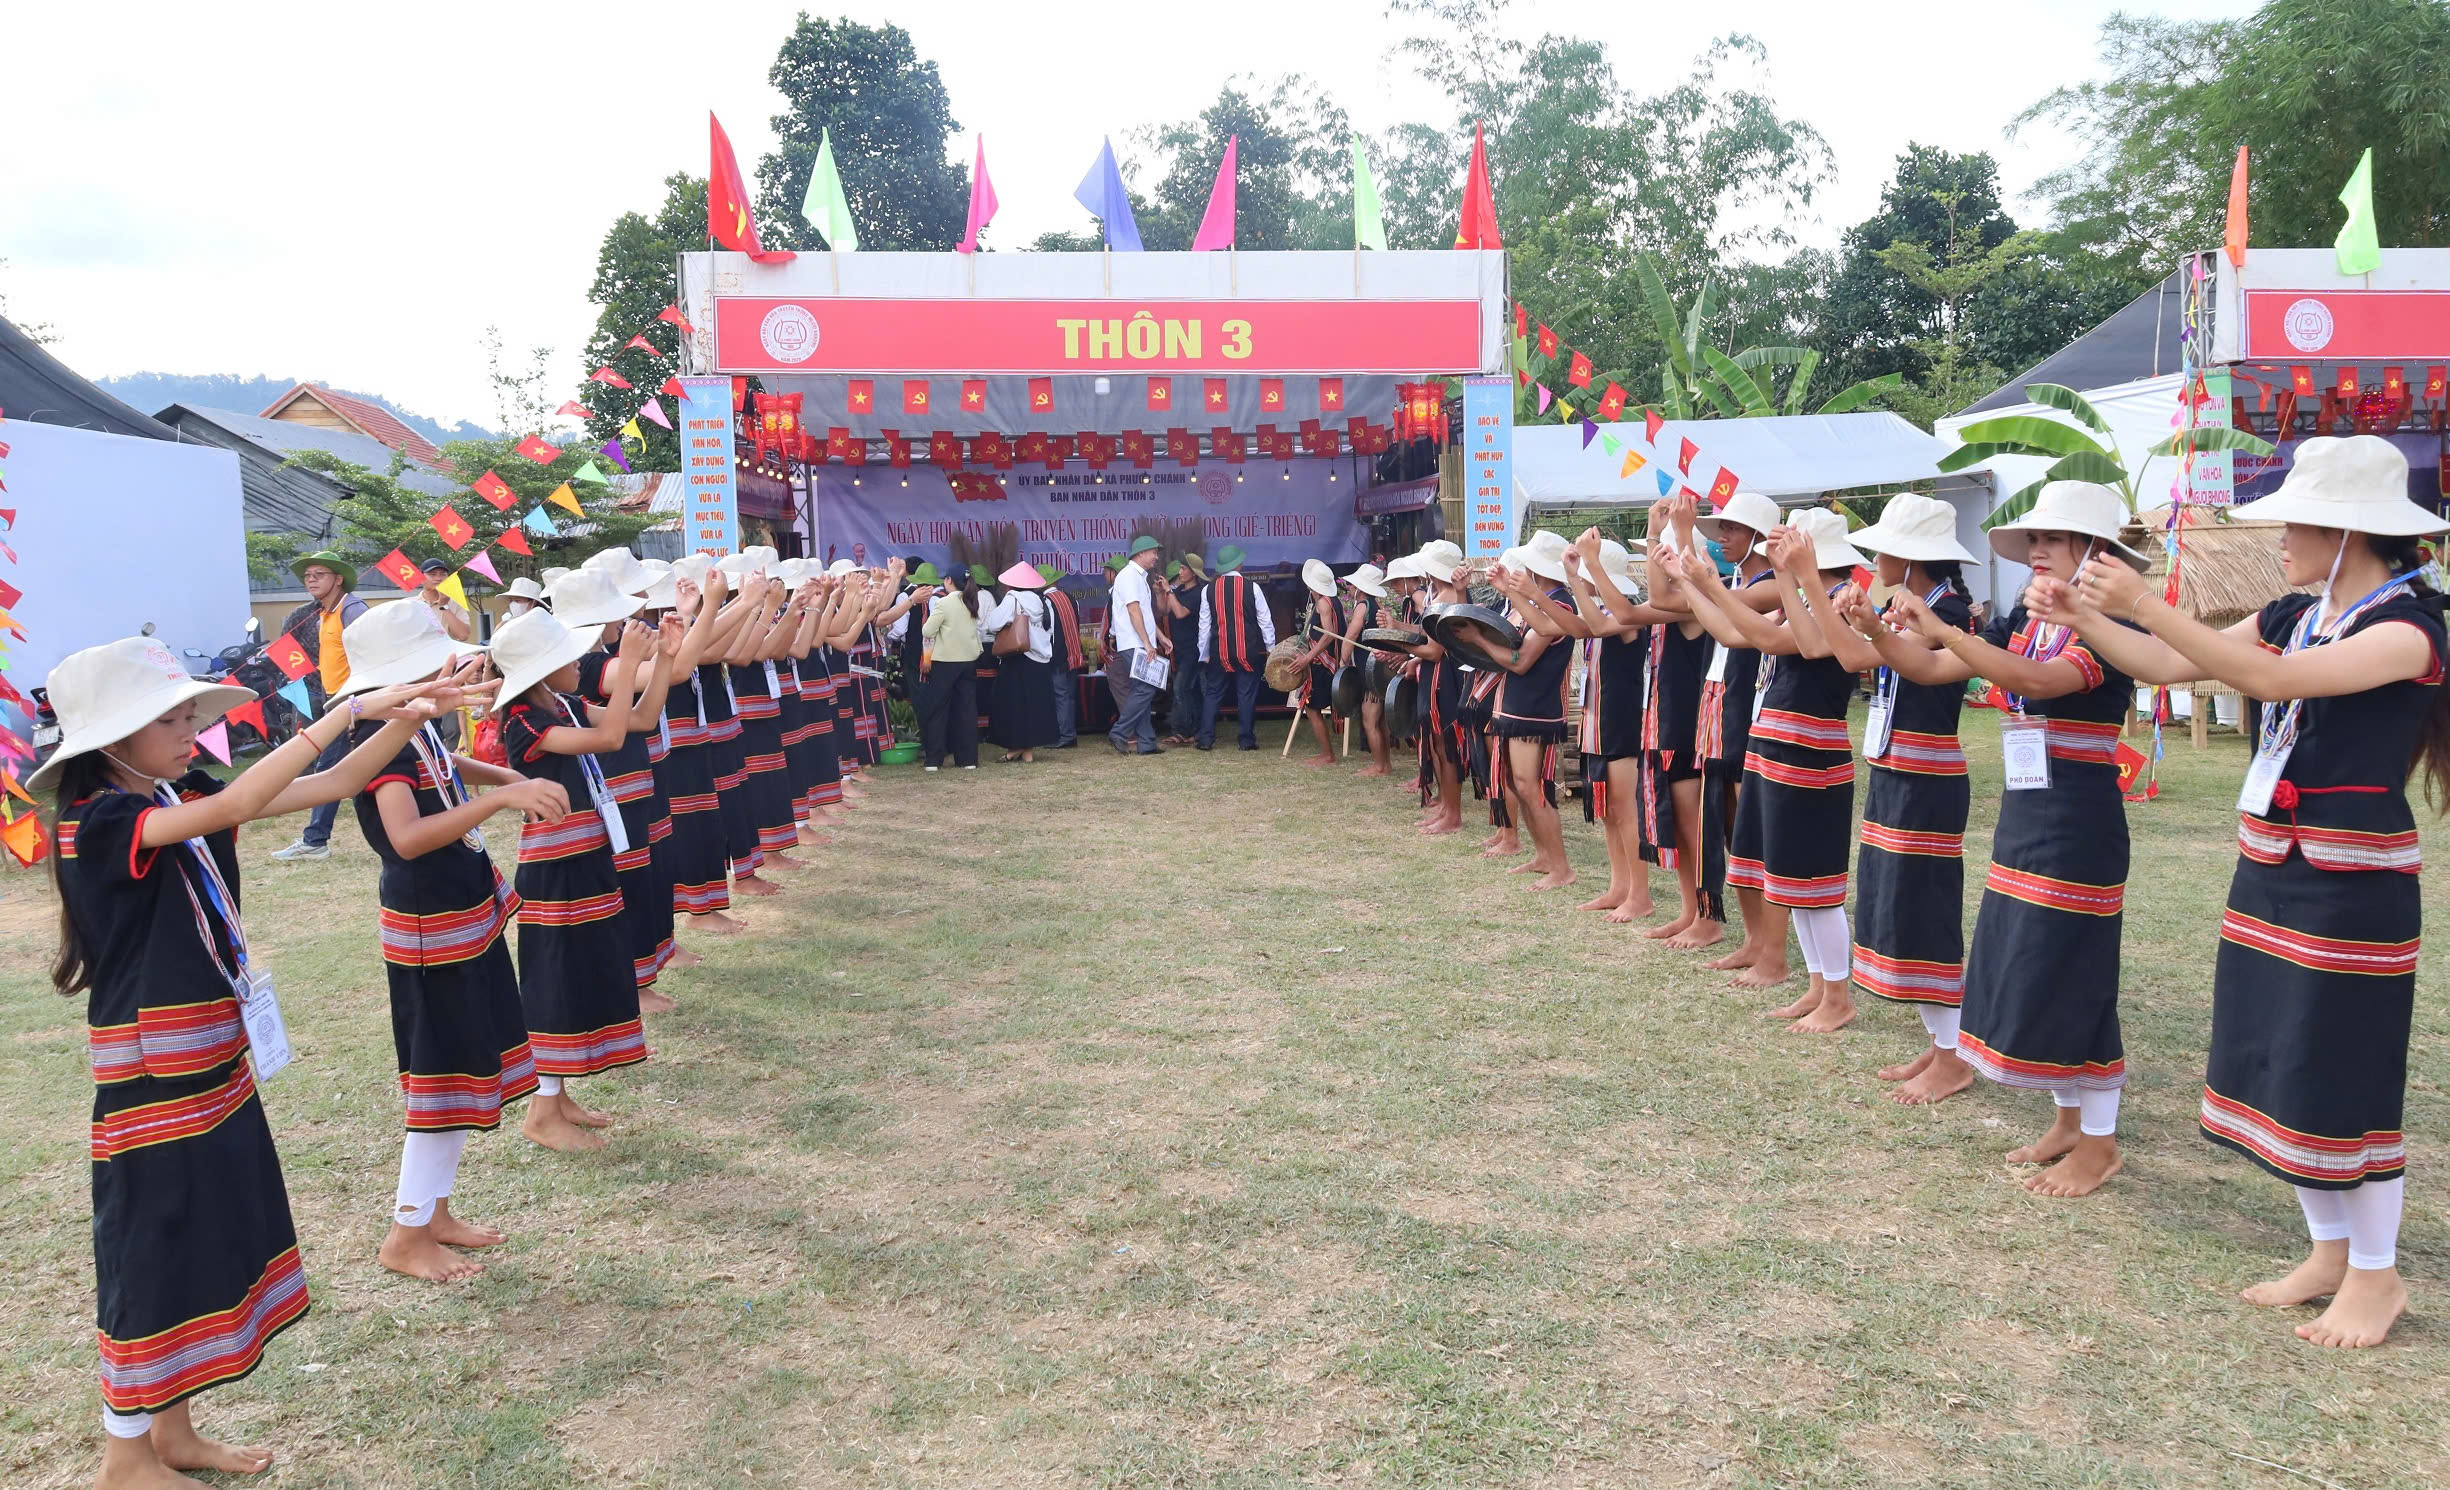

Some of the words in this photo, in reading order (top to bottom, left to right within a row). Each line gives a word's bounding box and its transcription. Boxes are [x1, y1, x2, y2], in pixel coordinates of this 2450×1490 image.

[1056, 310, 1202, 359] THÔN
[1221, 319, 1254, 359] 3
[690, 475, 704, 485] CON
[1056, 473, 1080, 486] NHÂN
[1154, 472, 1186, 485] CHÁNH
[1050, 491, 1069, 502] BAN
[1072, 490, 1097, 502] NHÂN
[1100, 490, 1118, 502] DÂN
[1121, 489, 1147, 501] THÔN
[1149, 490, 1156, 501] 3
[887, 518, 924, 545] NGÀY
[929, 518, 953, 546] HỘI
[1022, 514, 1076, 541] TRUYỀN
[1081, 513, 1127, 541] THỐNG
[1479, 538, 1501, 549] TRONG
